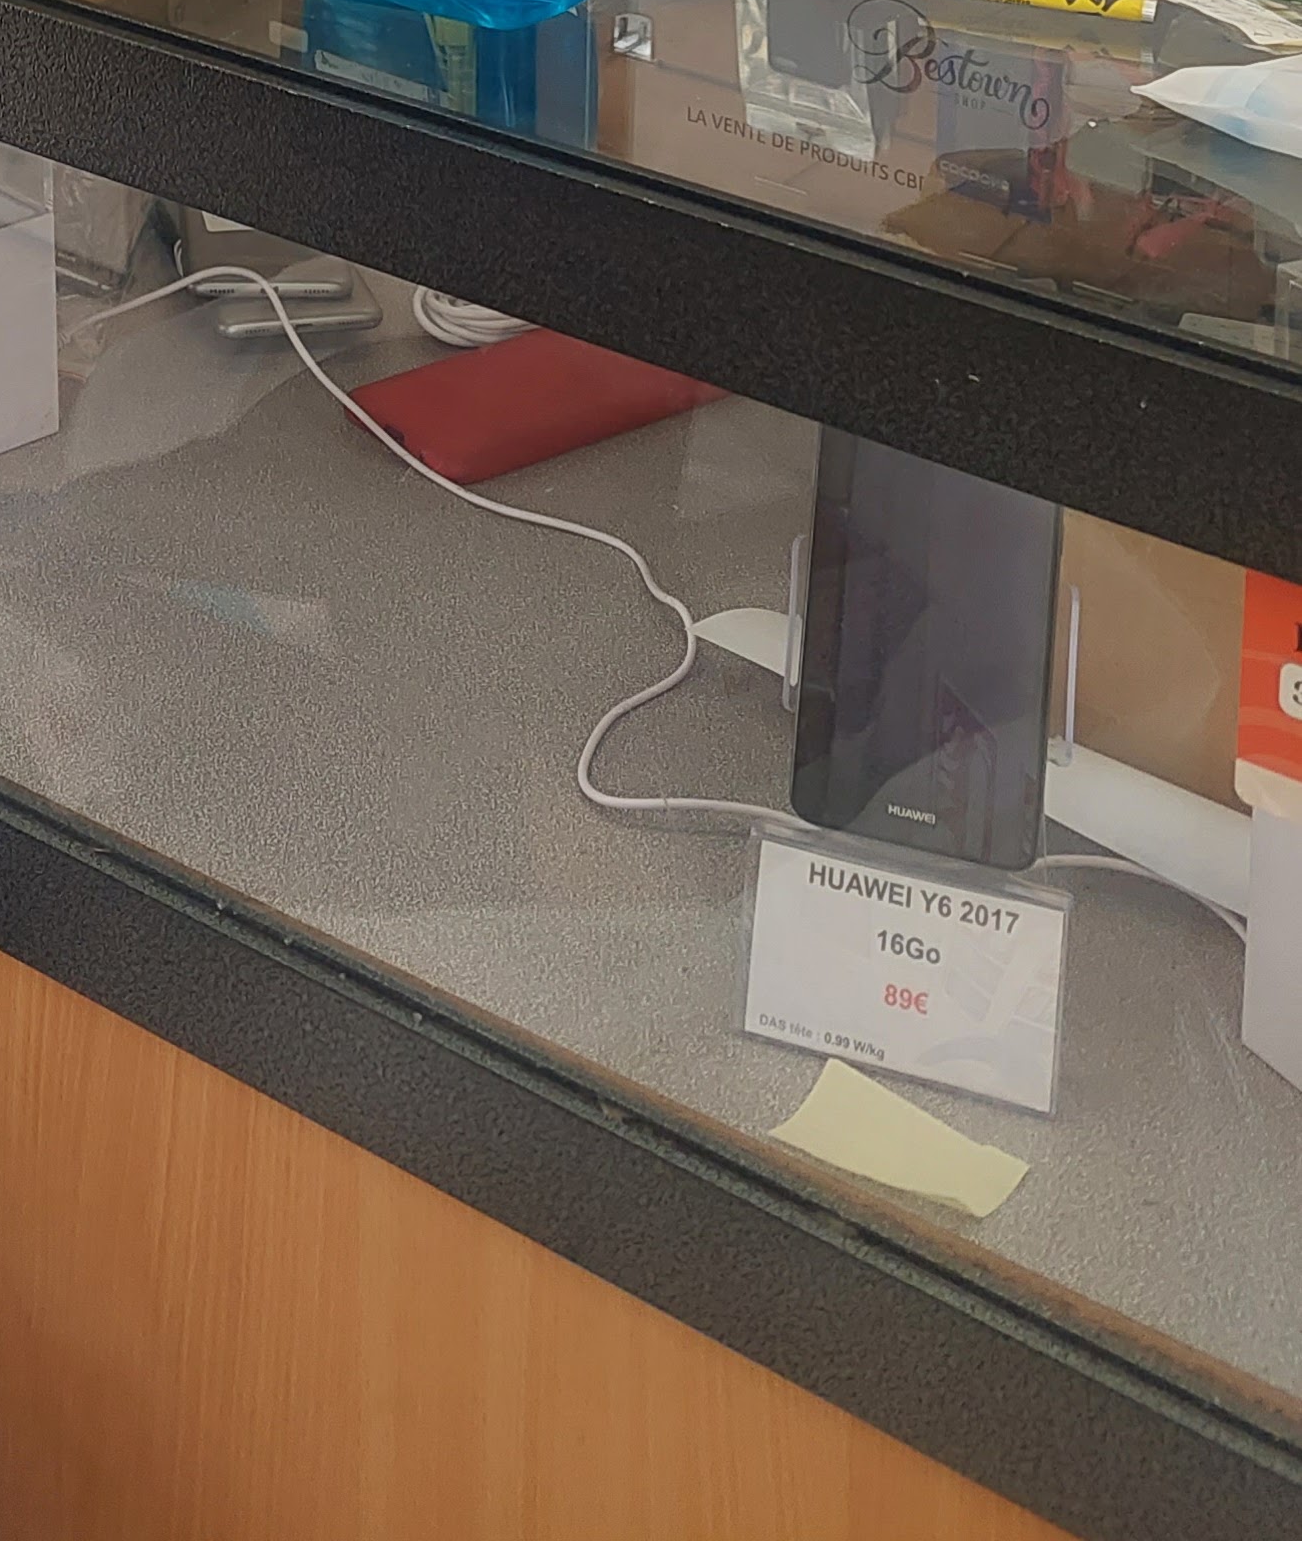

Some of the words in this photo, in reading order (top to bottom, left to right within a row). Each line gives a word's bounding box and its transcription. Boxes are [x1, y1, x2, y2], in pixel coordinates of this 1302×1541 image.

[954, 95, 988, 111] SHOP
[686, 105, 706, 126] LA
[771, 130, 796, 154] DE
[799, 139, 890, 183] PRODUITS
[886, 803, 937, 826] HUAWEI
[807, 861, 913, 909] HUAWEI
[919, 889, 953, 918] Y6
[958, 900, 1020, 934] 2017
[876, 929, 942, 965] 16Go
[882, 983, 929, 1015] 89€
[758, 1012, 787, 1034] DAS
[789, 1020, 814, 1039] tête
[823, 1030, 851, 1050] 0.99
[852, 1038, 886, 1062] W/kg
